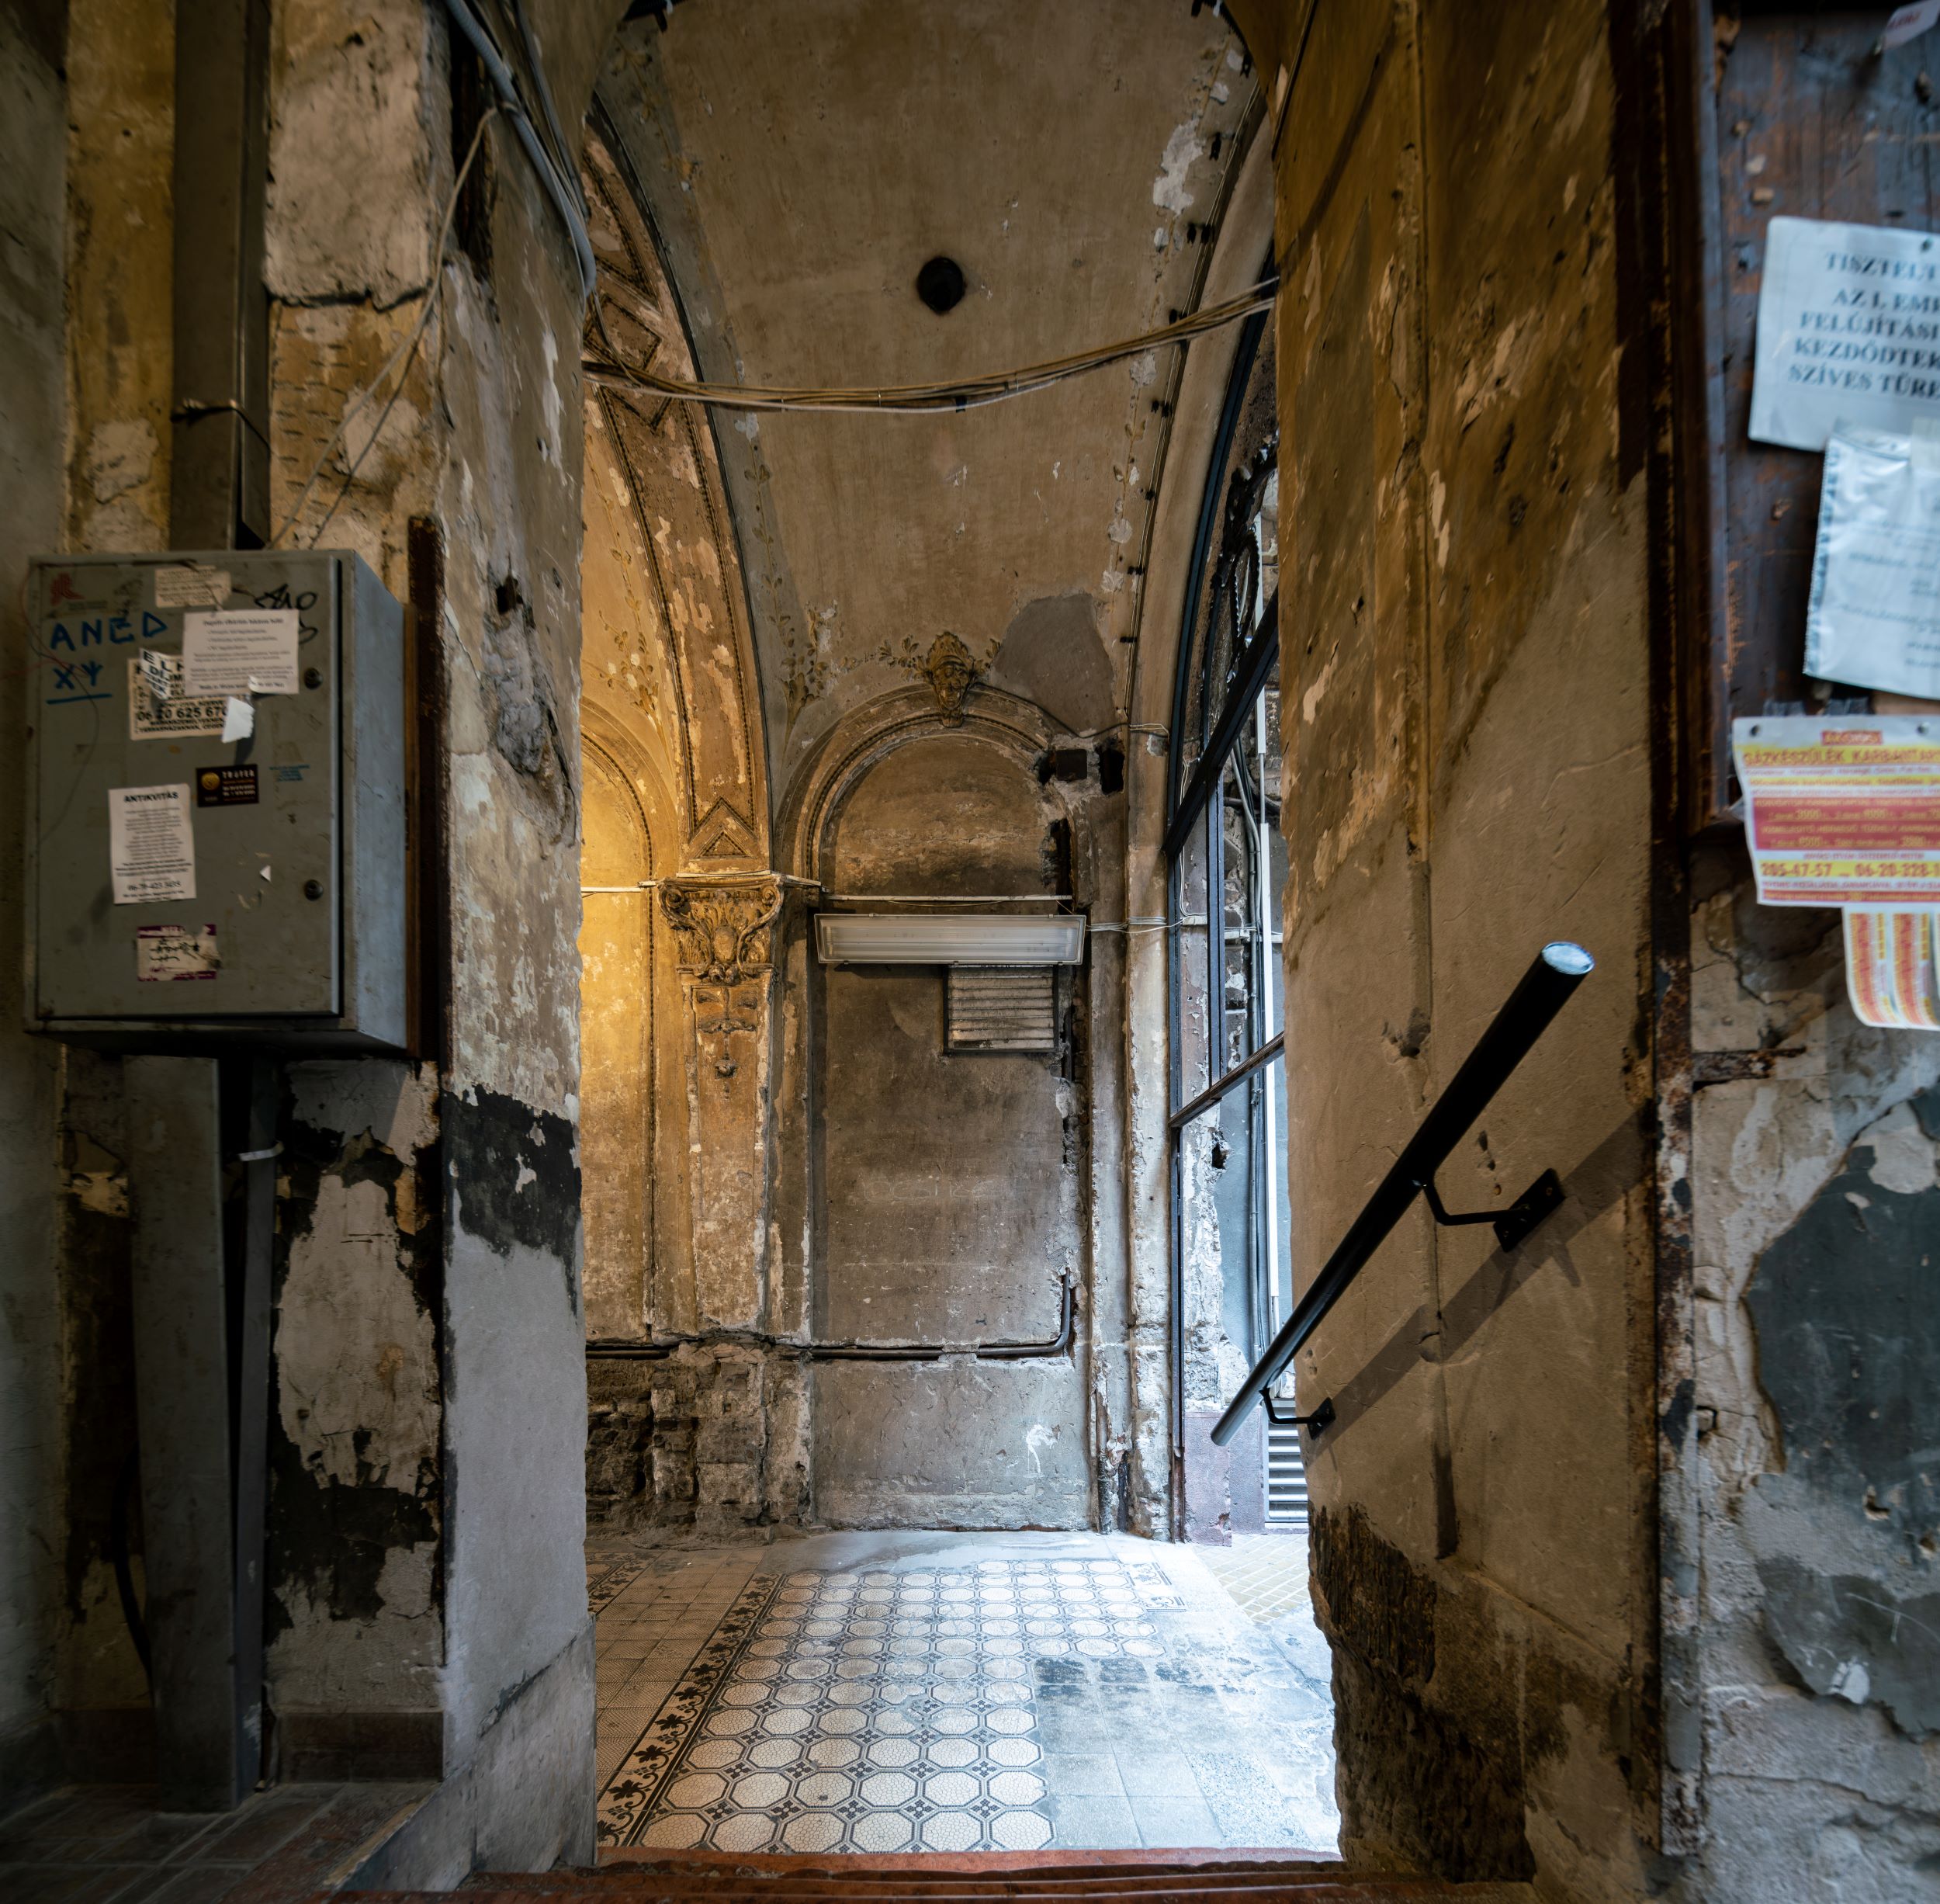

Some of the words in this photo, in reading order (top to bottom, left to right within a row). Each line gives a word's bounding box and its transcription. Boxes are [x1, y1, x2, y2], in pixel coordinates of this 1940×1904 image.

[1788, 362, 1872, 390] SZÍVES
[176, 707, 201, 718] 625
[123, 791, 178, 803] ANTIKVITÁS
